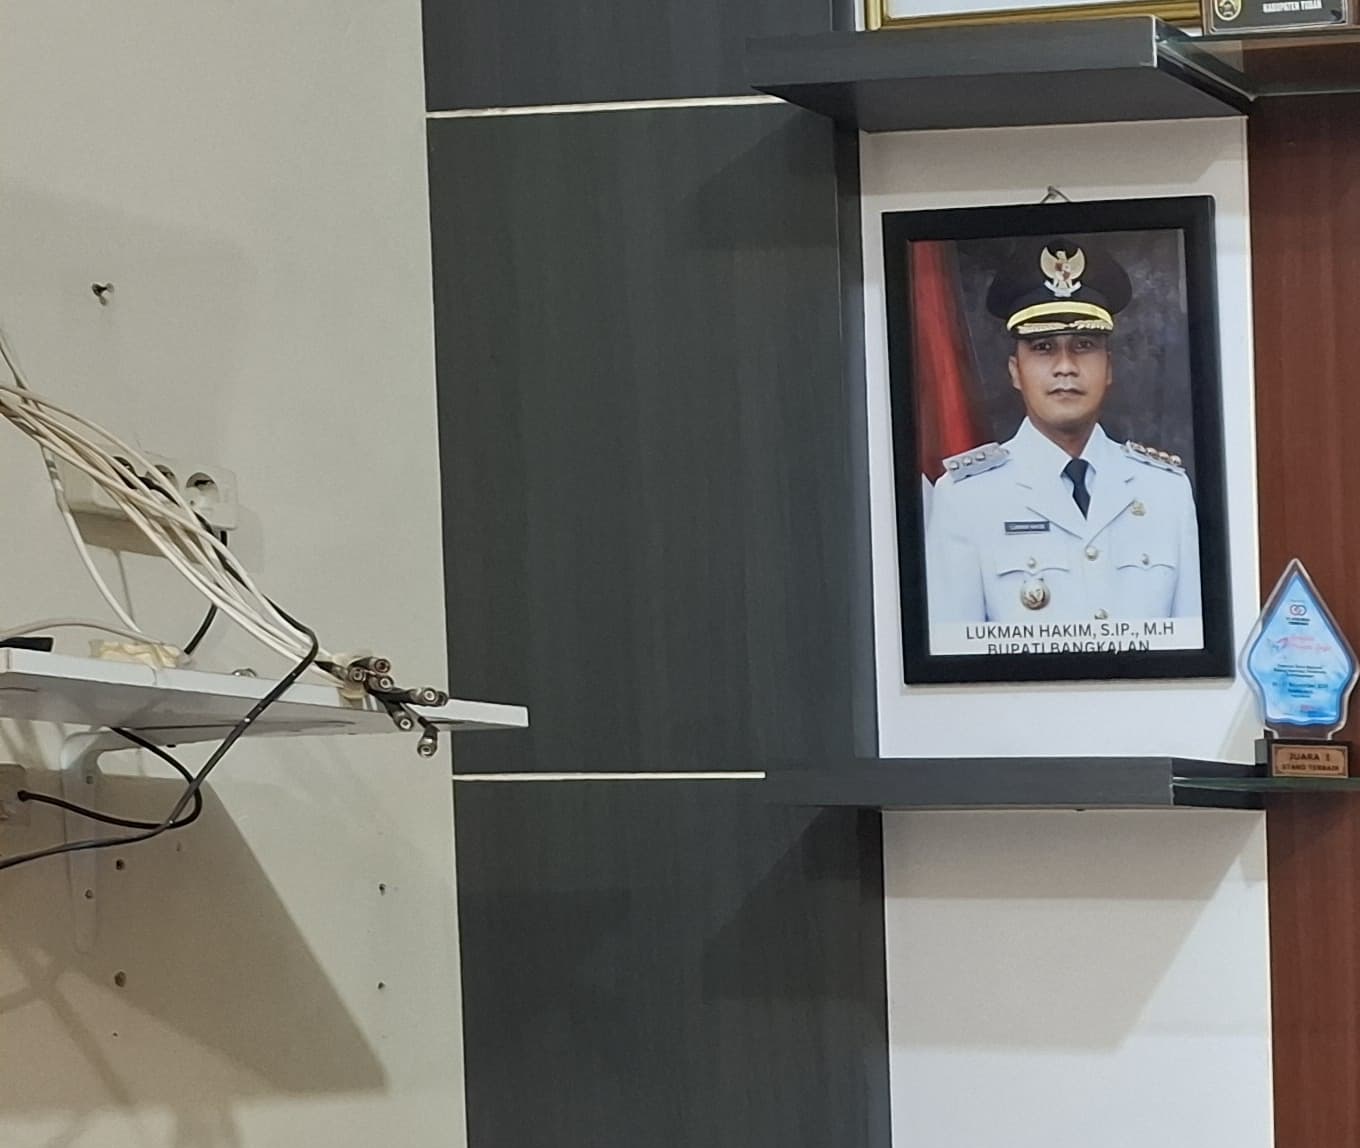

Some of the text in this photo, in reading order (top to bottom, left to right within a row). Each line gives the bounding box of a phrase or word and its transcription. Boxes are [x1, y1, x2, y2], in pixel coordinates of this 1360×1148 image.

[966, 624, 1034, 640] LUKMAN
[1039, 623, 1097, 639] HAKIM,
[1143, 621, 1175, 636] M.H
[987, 641, 1047, 655] BUPATI
